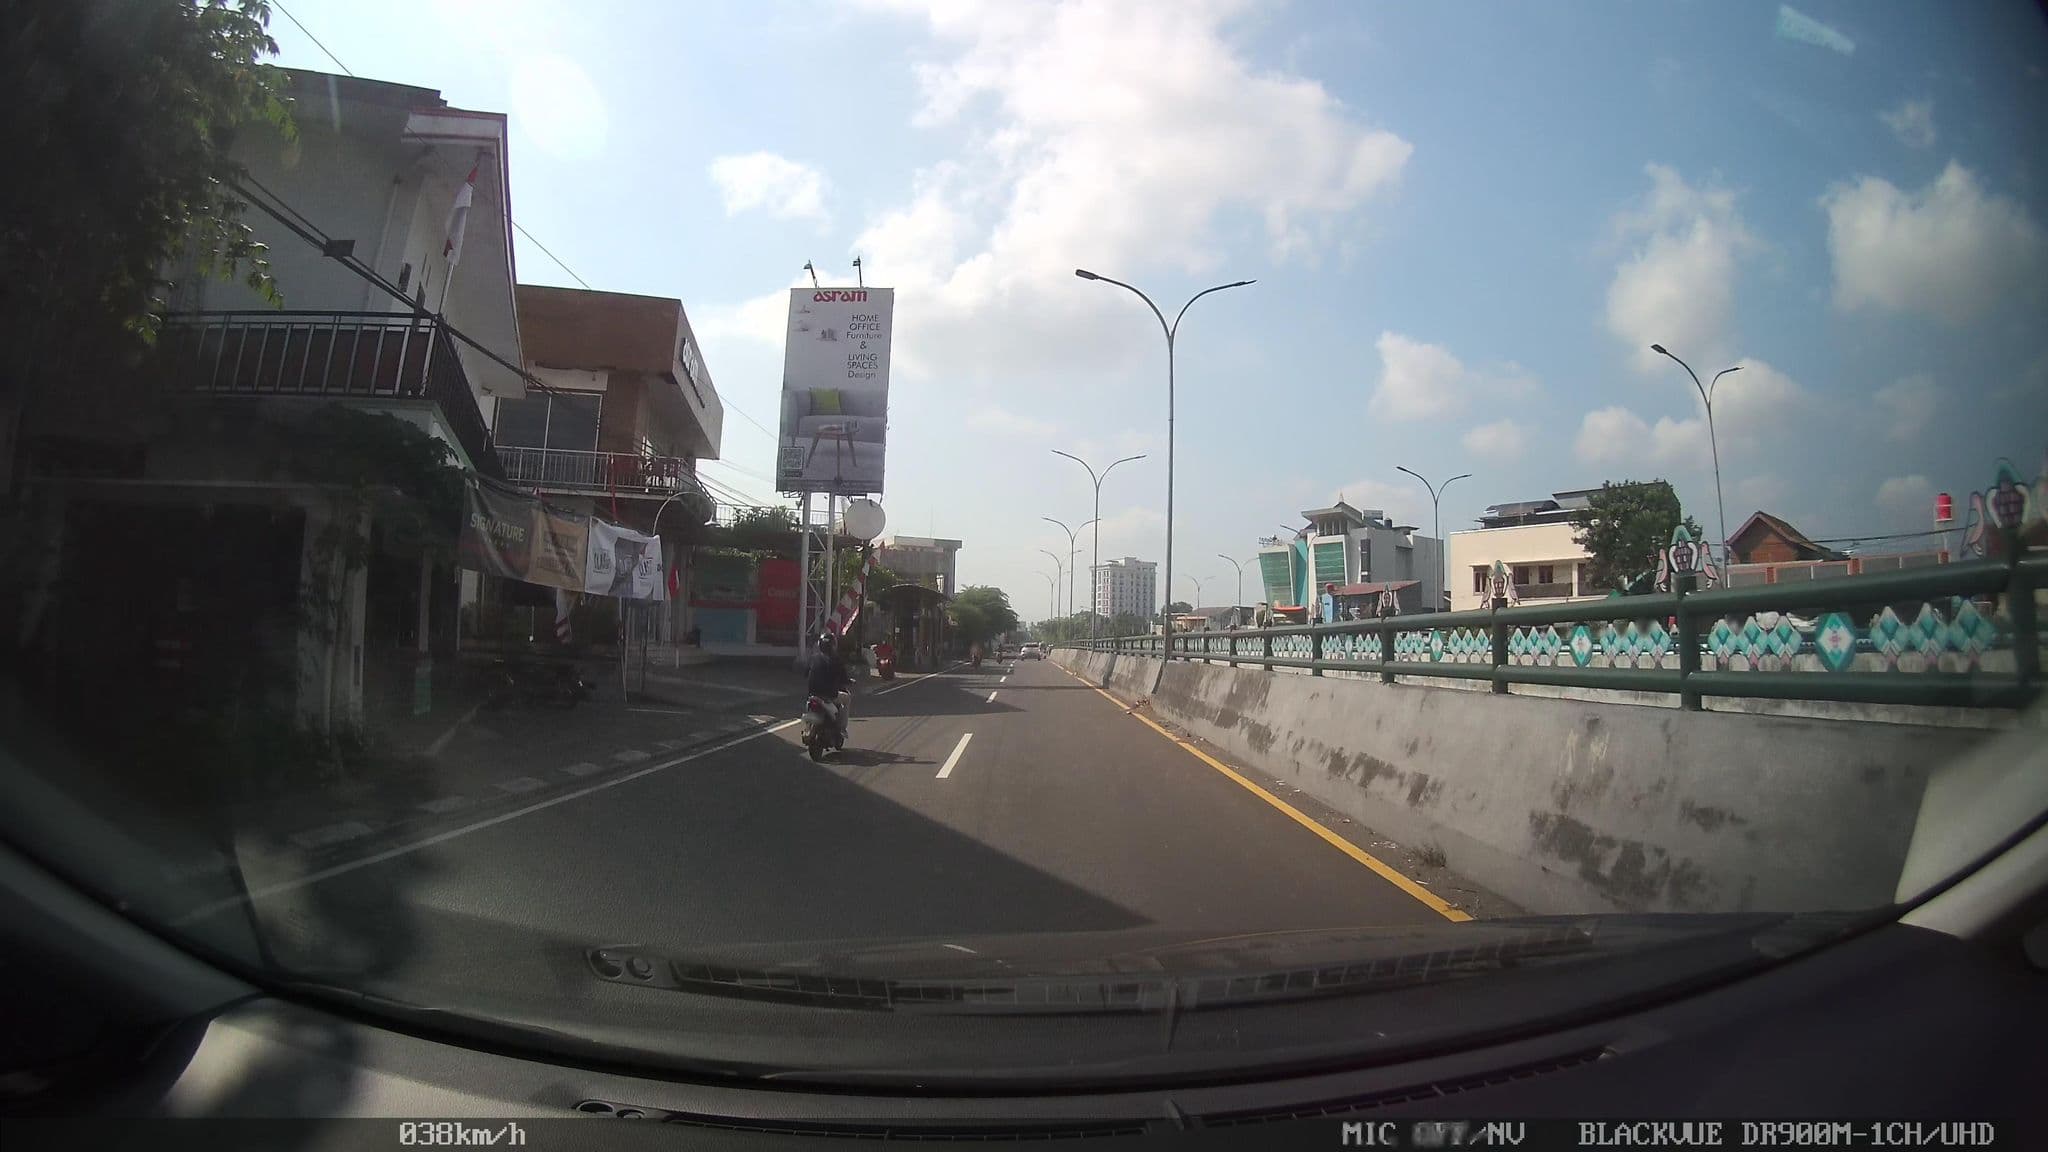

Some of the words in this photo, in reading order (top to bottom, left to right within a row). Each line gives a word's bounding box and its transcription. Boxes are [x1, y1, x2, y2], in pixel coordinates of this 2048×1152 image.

[813, 290, 868, 302] asram
[852, 314, 880, 322] HOME
[849, 323, 881, 331] OFFICE
[846, 331, 882, 340] Furniture
[860, 341, 867, 350] &
[848, 353, 878, 361] LIVING
[847, 361, 879, 370] SPACES
[847, 371, 877, 380] Design
[470, 512, 525, 543] SIGNATURE
